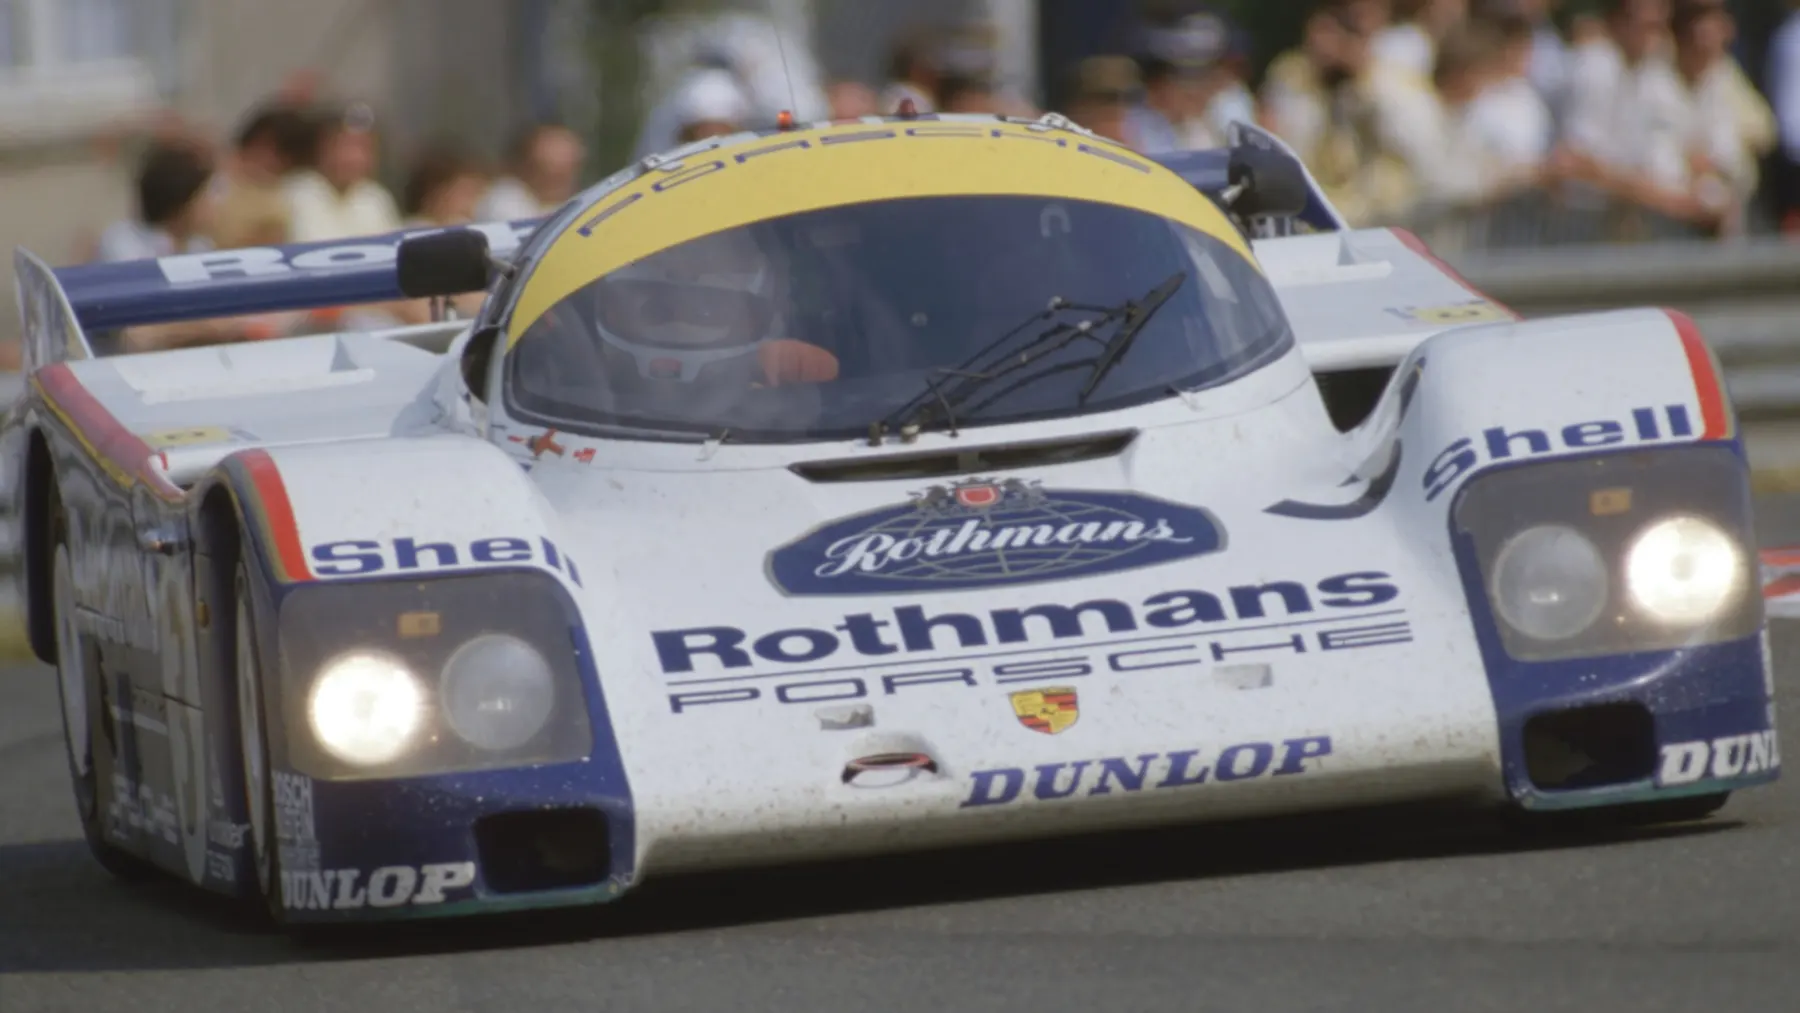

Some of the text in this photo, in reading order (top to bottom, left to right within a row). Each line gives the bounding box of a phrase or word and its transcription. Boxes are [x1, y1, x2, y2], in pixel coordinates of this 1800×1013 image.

[1422, 404, 1693, 502] Shell
[311, 537, 584, 589] Shell
[814, 516, 1194, 578] Rothmans
[650, 571, 1400, 673] Rothmans
[668, 621, 1414, 713] PORSCHE
[960, 735, 1333, 808] DUNLOP
